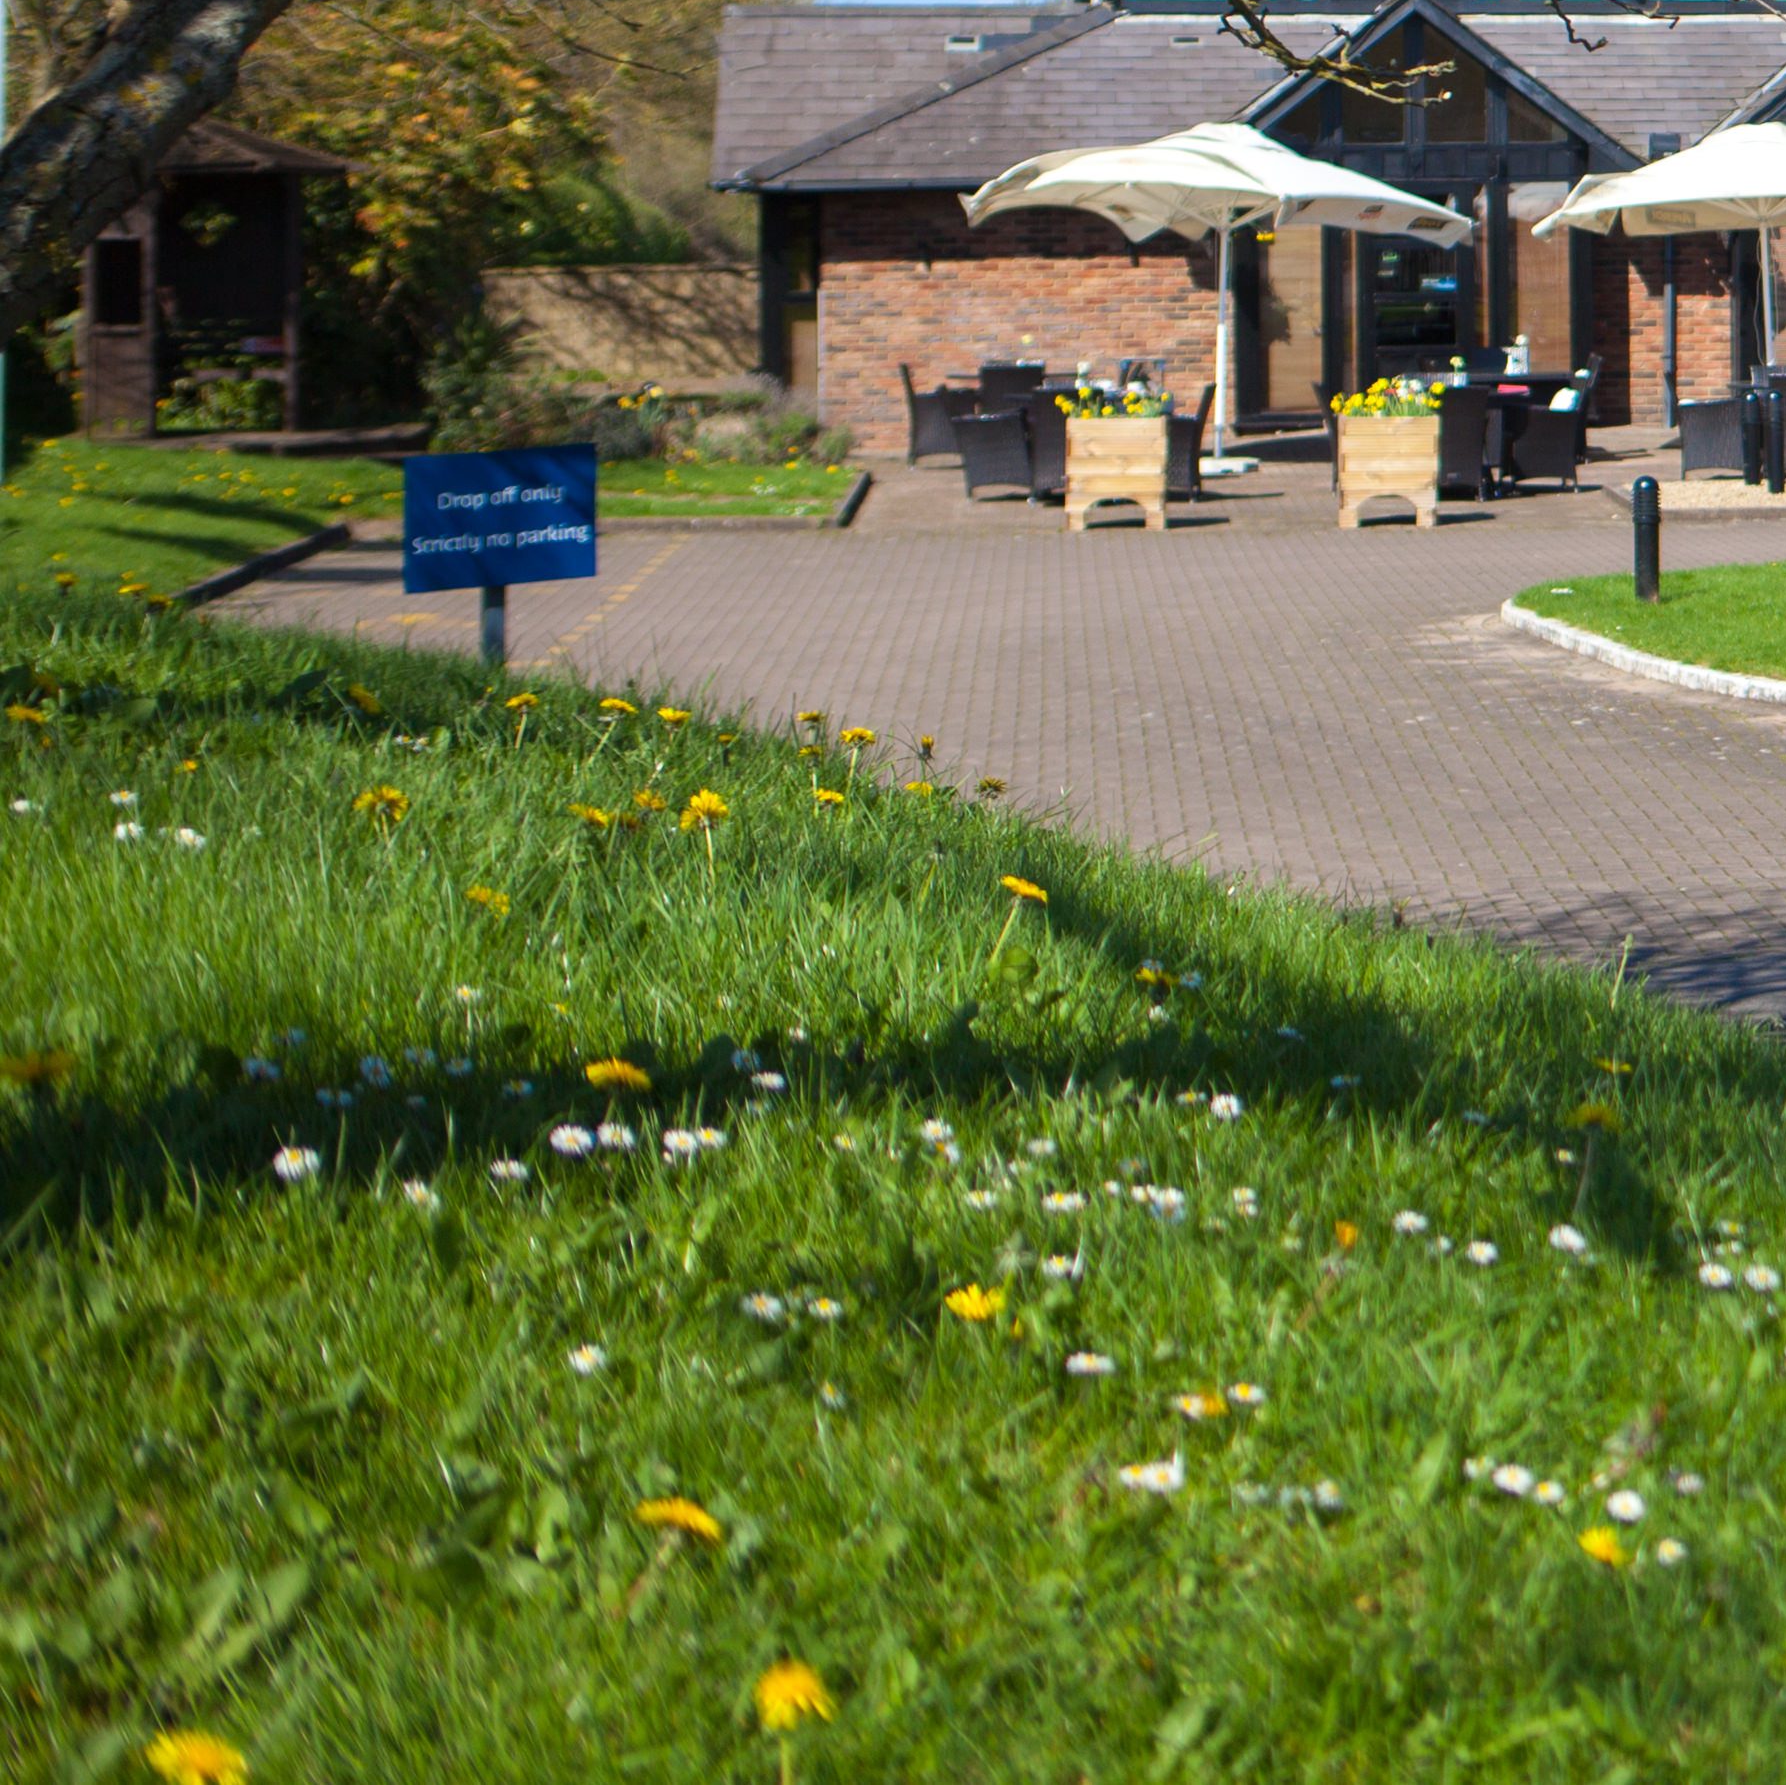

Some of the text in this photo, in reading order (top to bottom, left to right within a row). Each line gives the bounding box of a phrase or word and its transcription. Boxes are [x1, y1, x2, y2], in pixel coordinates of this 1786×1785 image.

[437, 484, 564, 510] Drop off only
[412, 523, 592, 554] Strictly no parking
